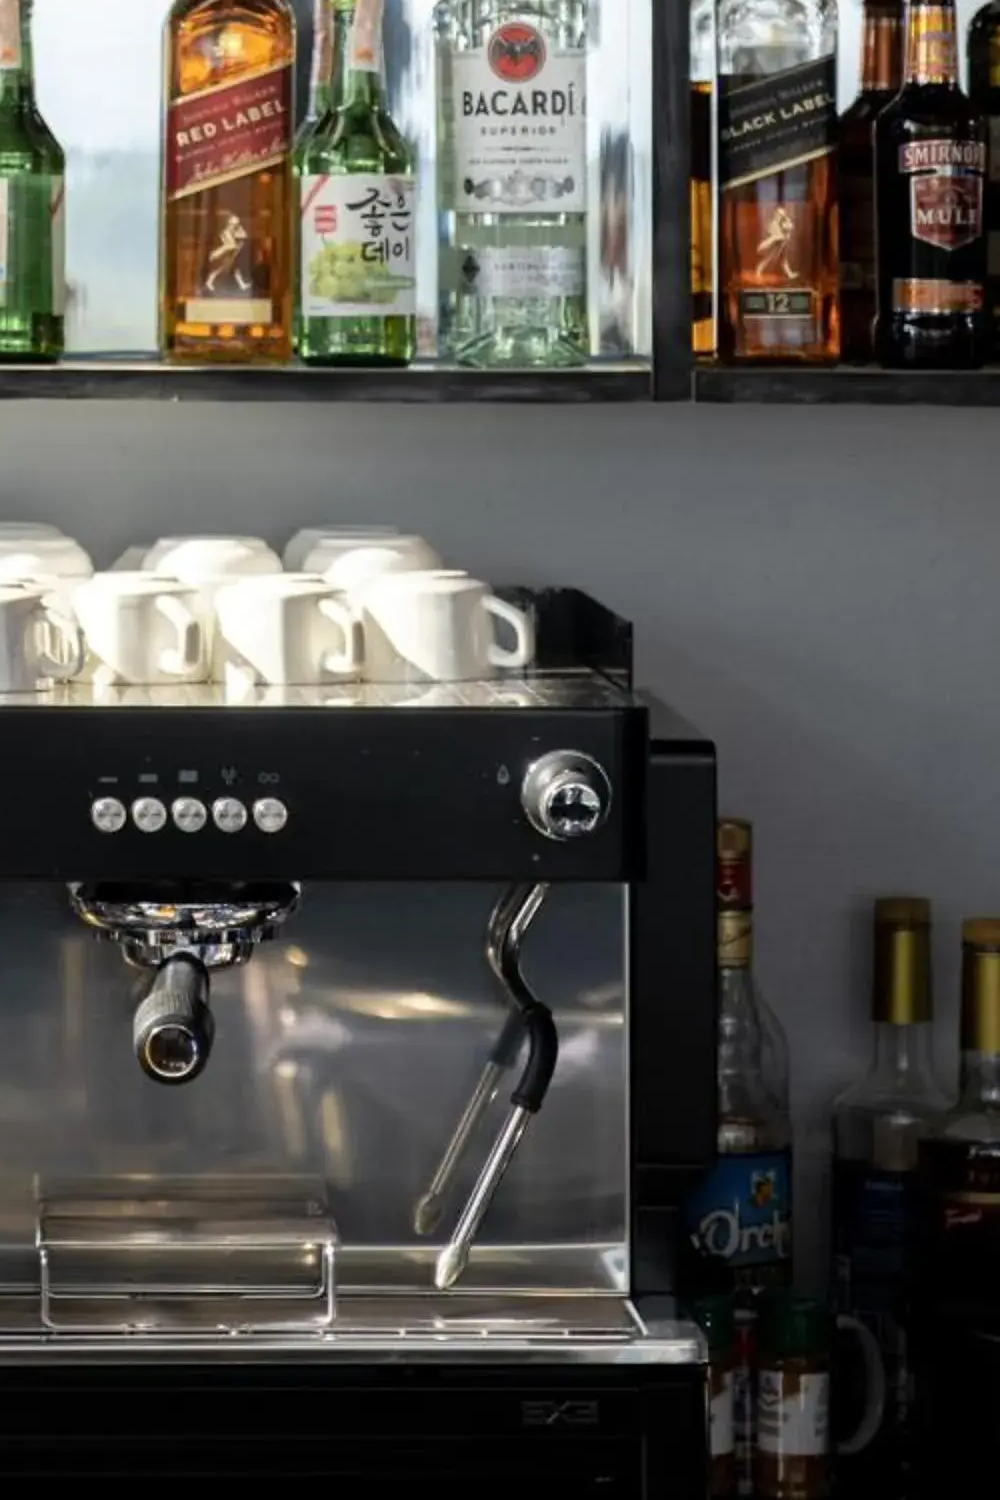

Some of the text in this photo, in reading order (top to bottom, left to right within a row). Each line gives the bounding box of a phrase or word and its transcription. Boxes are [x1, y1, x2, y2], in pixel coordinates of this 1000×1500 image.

[463, 83, 574, 117] BACARDÍ
[780, 93, 833, 119] LABEL
[175, 122, 218, 148] RED
[220, 99, 285, 132] LABEL
[481, 125, 556, 137] SUPERIOR
[346, 187, 412, 237] 좋은
[361, 236, 410, 268] 데이
[766, 296, 790, 312] 12
[521, 1400, 599, 1425] EX3
